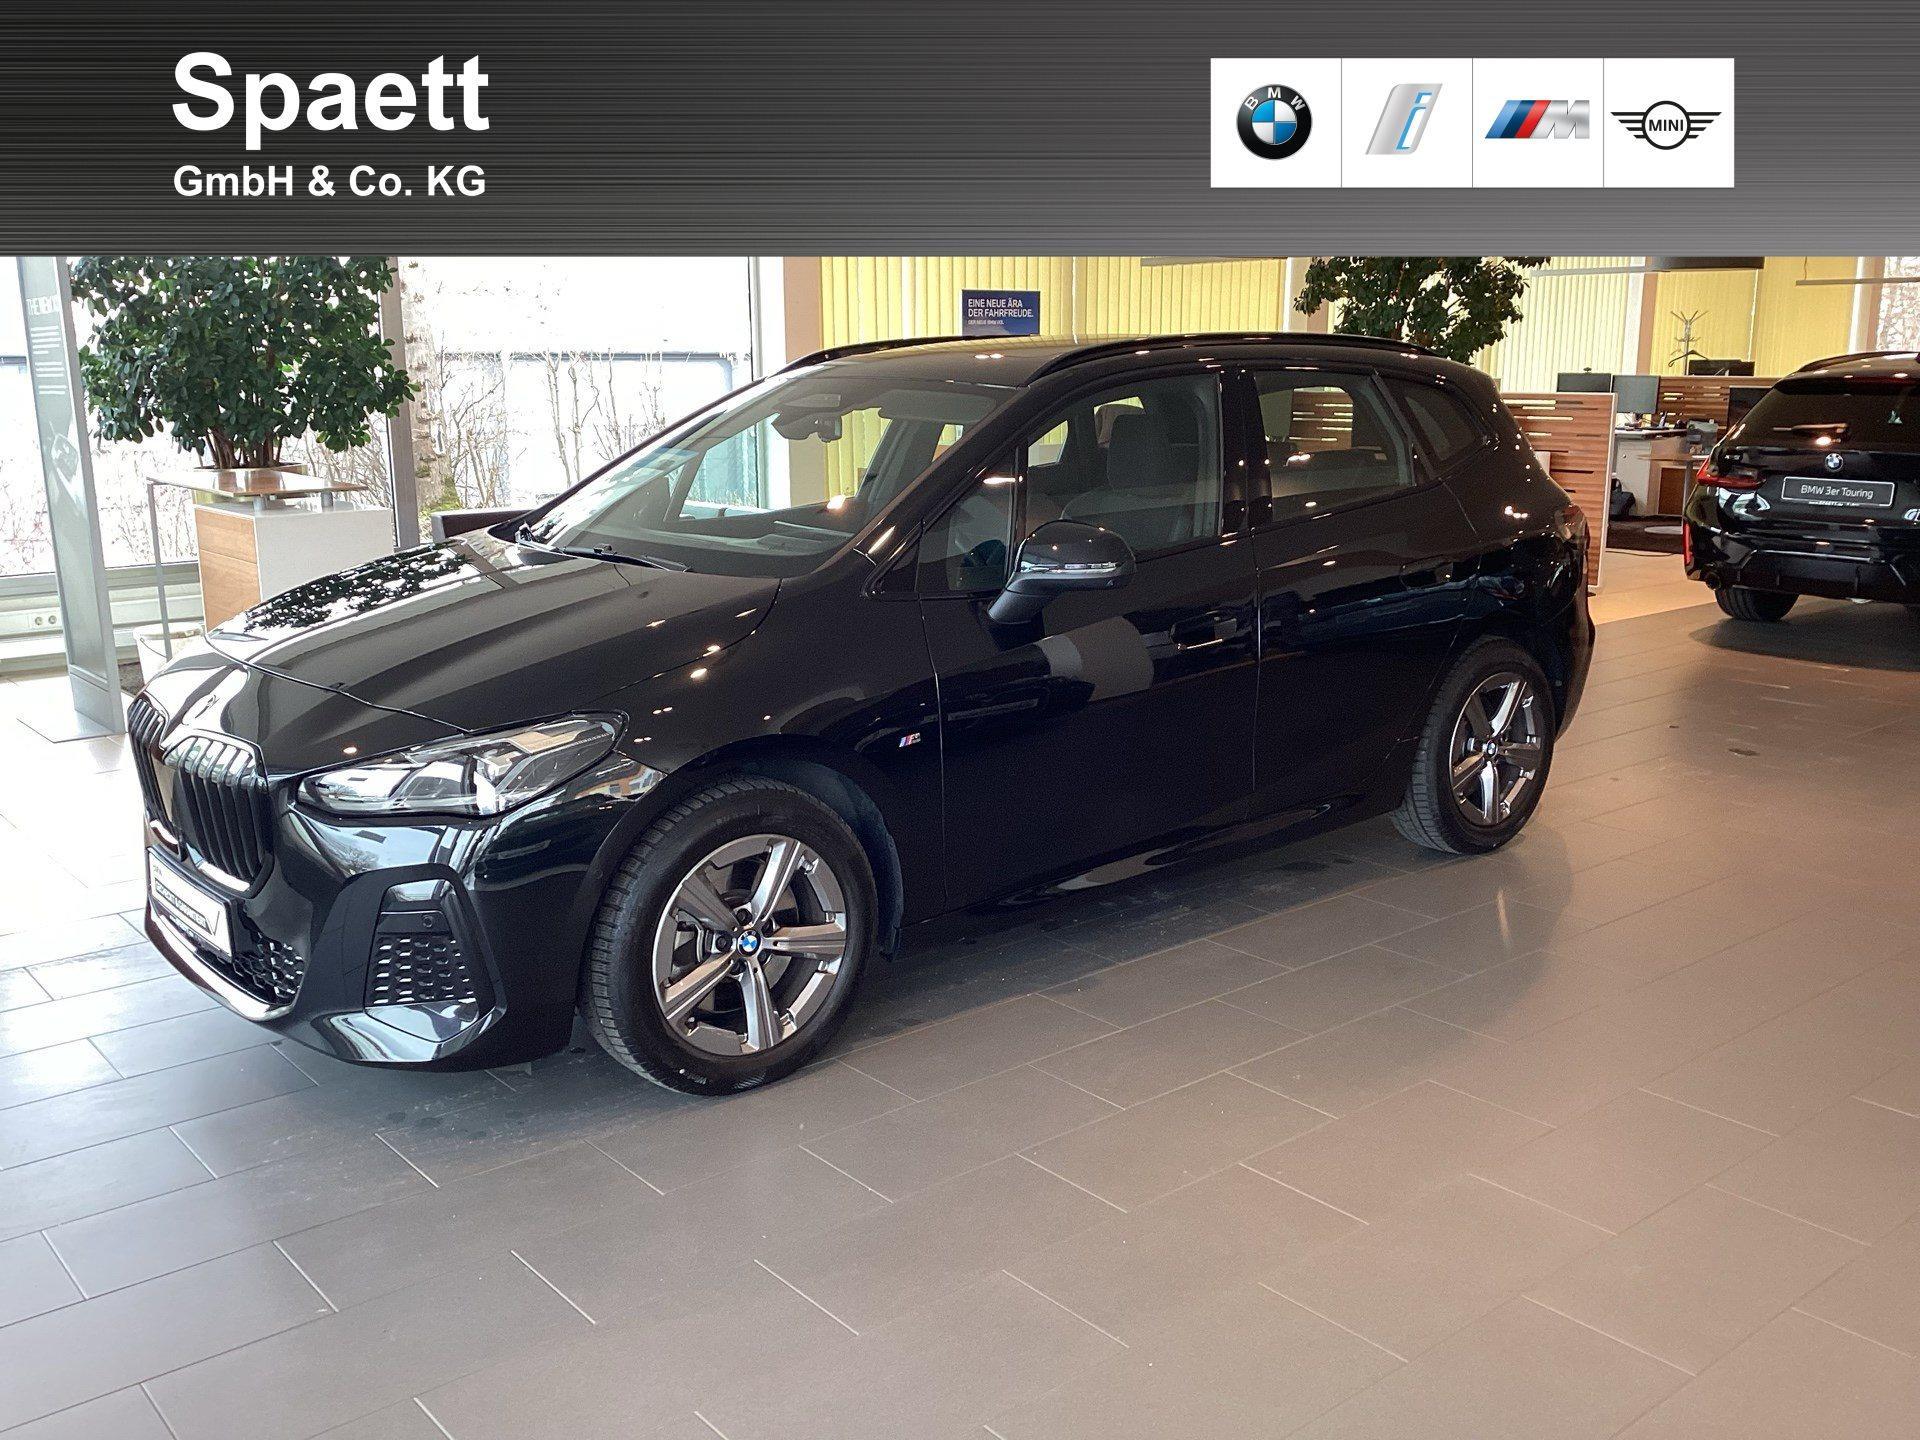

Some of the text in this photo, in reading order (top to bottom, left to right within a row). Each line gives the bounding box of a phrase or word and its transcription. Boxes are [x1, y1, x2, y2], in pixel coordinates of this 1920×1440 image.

[968, 298, 1023, 308] EINE NEUE ÄRA
[968, 308, 1034, 318] DER FAHRFREUDE.
[1800, 484, 1874, 500] BMW 3er Touring
